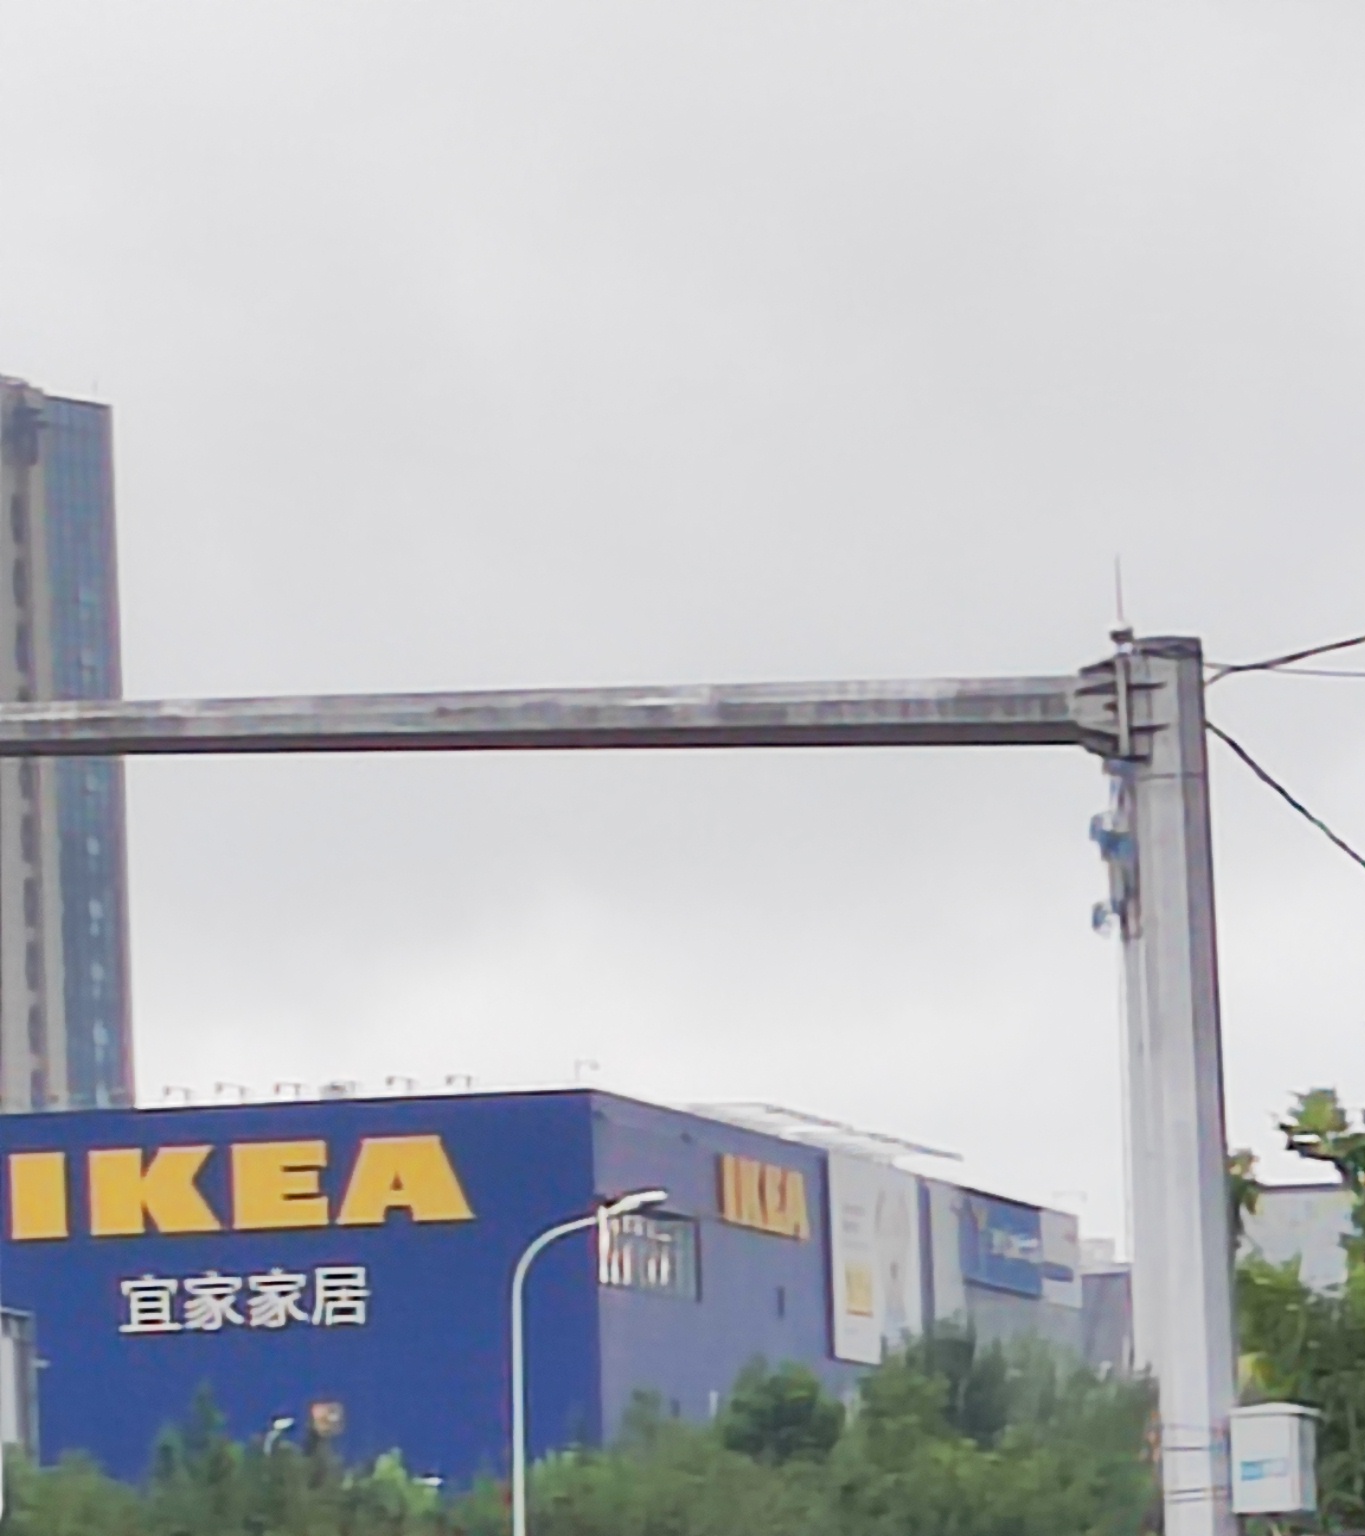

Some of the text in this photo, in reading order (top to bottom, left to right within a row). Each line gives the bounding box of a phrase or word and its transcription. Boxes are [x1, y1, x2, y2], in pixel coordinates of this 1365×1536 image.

[9, 1134, 476, 1240] IKEA
[722, 1152, 811, 1242] IKEA
[118, 1265, 370, 1334] 宜家家居
